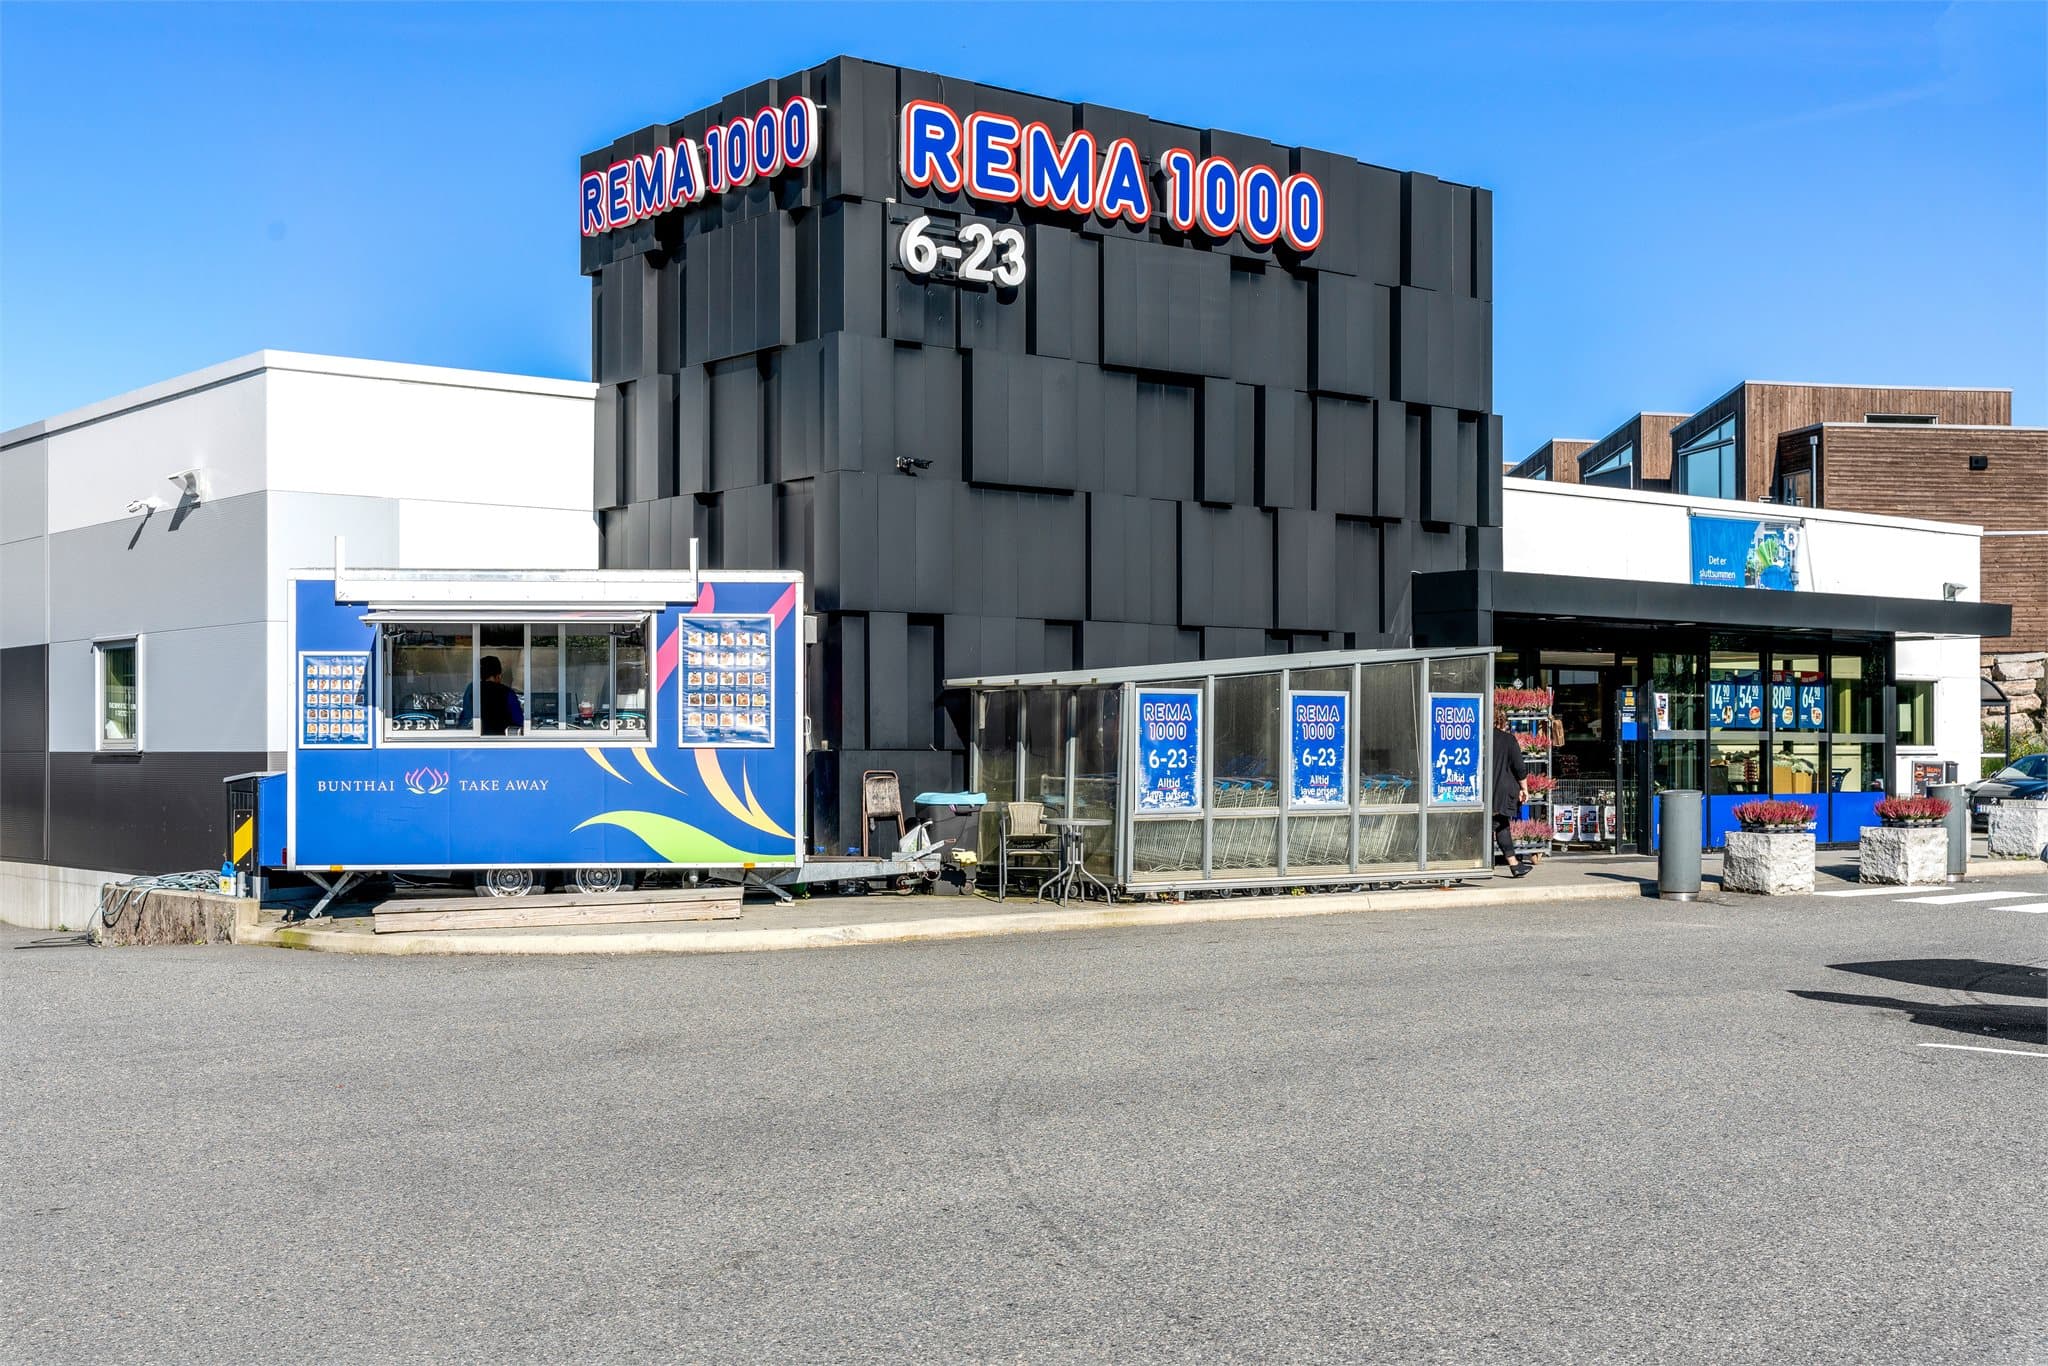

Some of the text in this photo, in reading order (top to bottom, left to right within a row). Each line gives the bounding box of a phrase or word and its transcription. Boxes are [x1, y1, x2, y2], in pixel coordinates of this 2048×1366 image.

[580, 96, 818, 238] REMA 1000
[901, 99, 1324, 252] REMA 1000
[899, 215, 1026, 287] 6-23
[1708, 555, 1719, 565] Det
[1143, 703, 1192, 721] REMA
[1296, 705, 1340, 722] REMA
[1435, 707, 1475, 723] REMA
[392, 719, 439, 730] OPEN
[1149, 722, 1186, 741] 1000
[1302, 723, 1335, 740] 1000
[1440, 724, 1471, 740] 1000
[1149, 749, 1187, 769] 6-23
[1302, 748, 1336, 767] 6-23
[1439, 748, 1470, 766] 6-23
[317, 780, 549, 792] BUNTHAI TAKE AWAY
